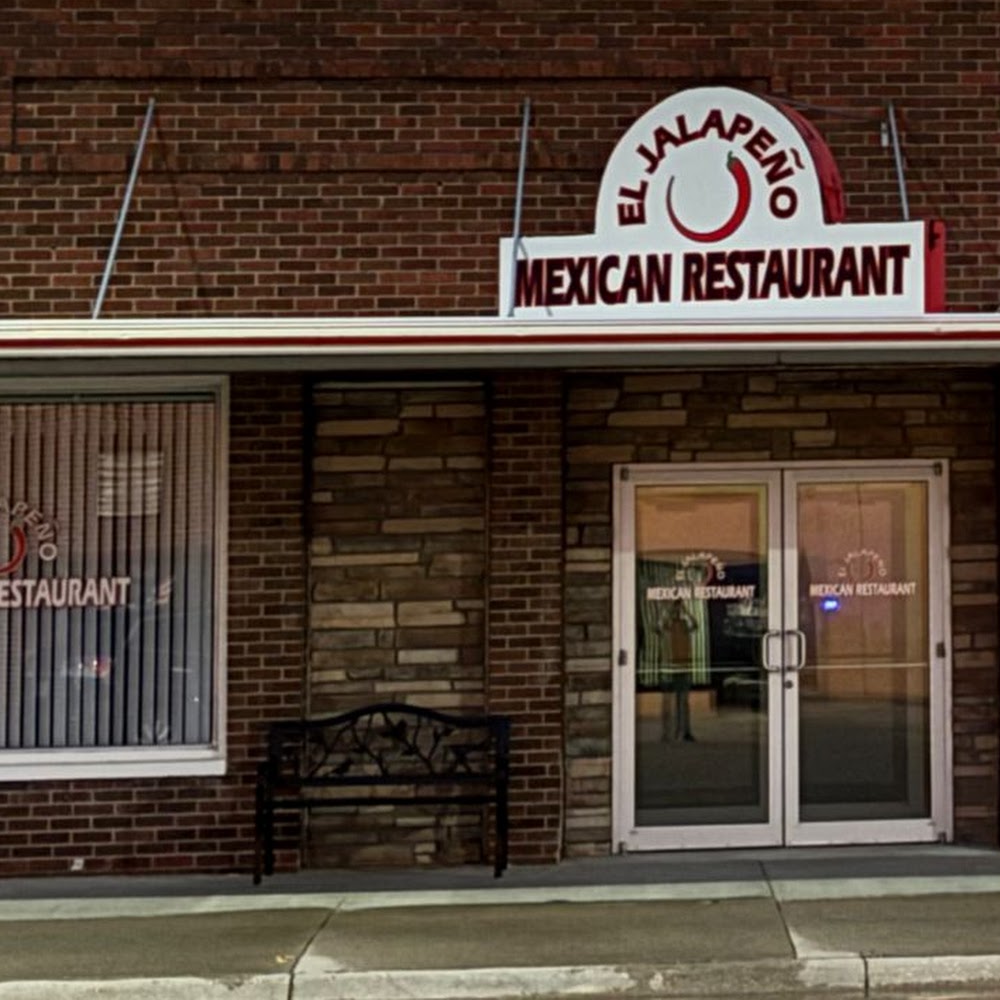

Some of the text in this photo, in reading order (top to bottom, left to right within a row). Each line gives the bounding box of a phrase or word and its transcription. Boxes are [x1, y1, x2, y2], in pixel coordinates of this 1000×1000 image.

[617, 109, 805, 226] EL JALAPEÑO
[514, 244, 911, 308] MEXICAN RESTAURANT
